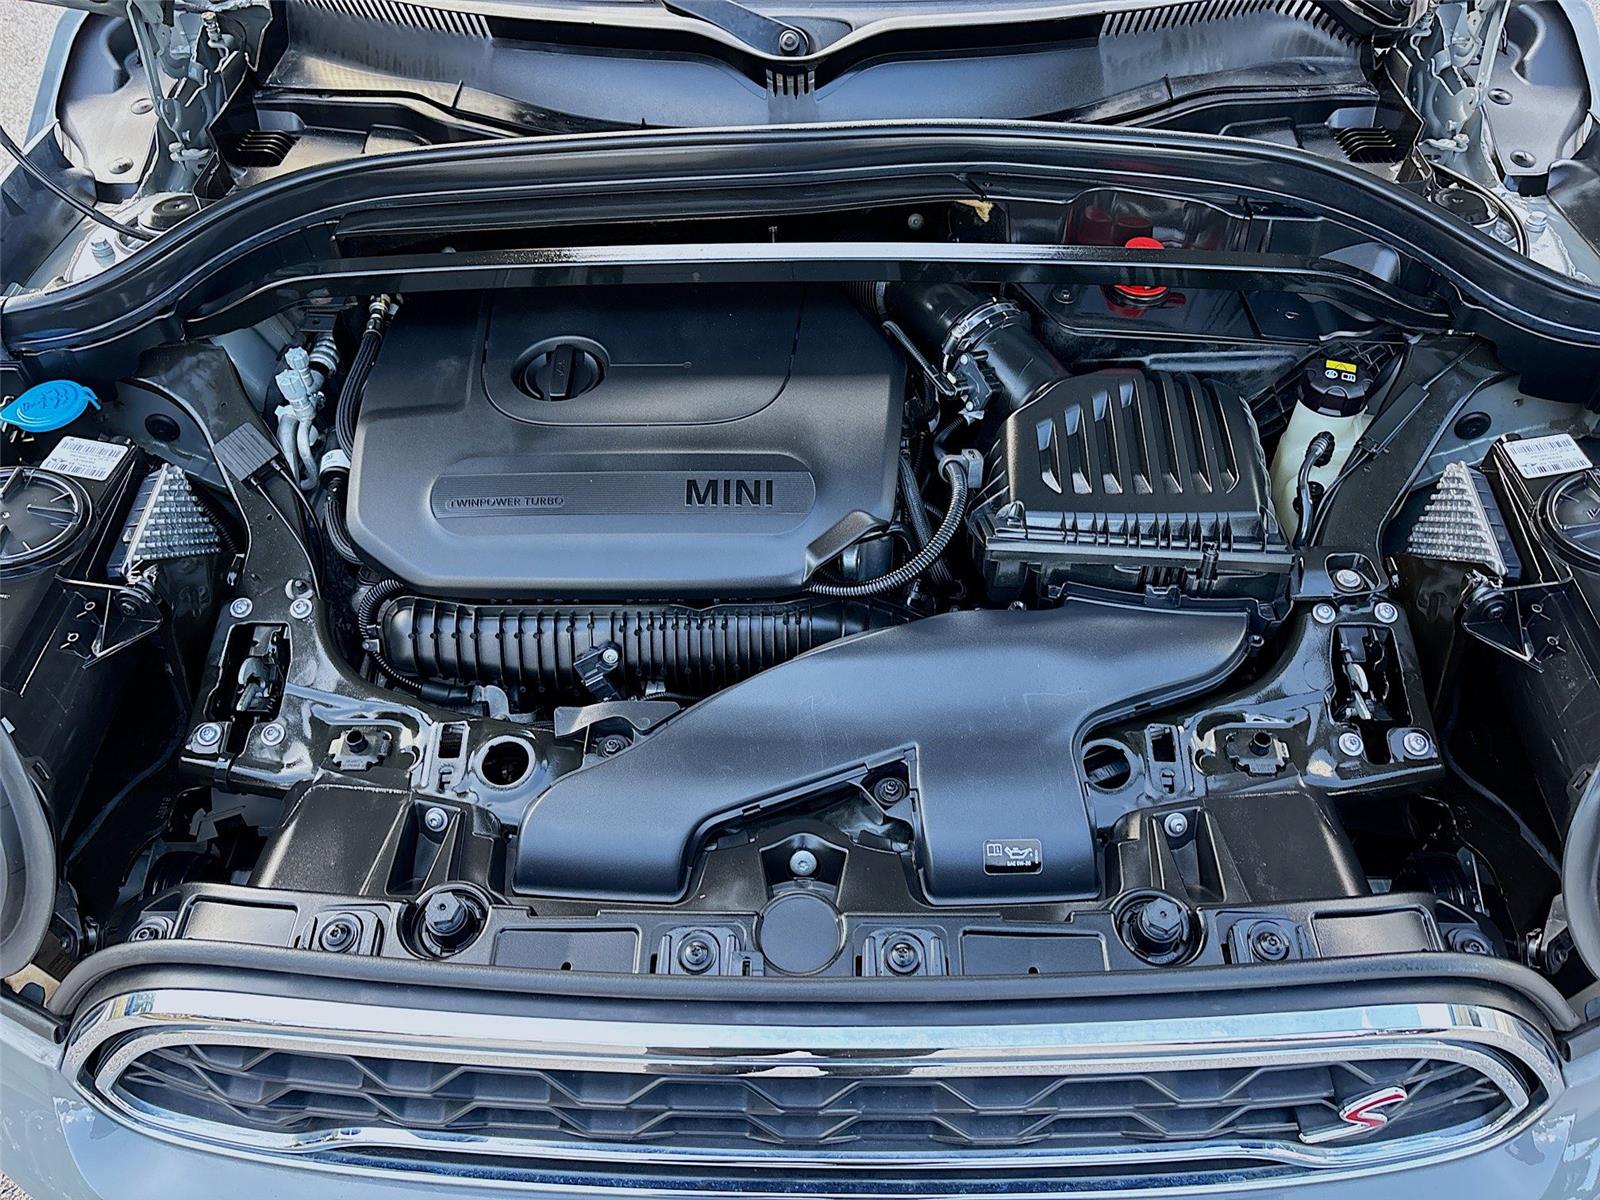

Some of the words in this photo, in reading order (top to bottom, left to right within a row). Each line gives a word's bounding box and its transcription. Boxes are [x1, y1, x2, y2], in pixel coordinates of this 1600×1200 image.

[448, 498, 521, 508] TWINPOWER
[524, 496, 564, 506] TURBO
[686, 479, 773, 506] MINI
